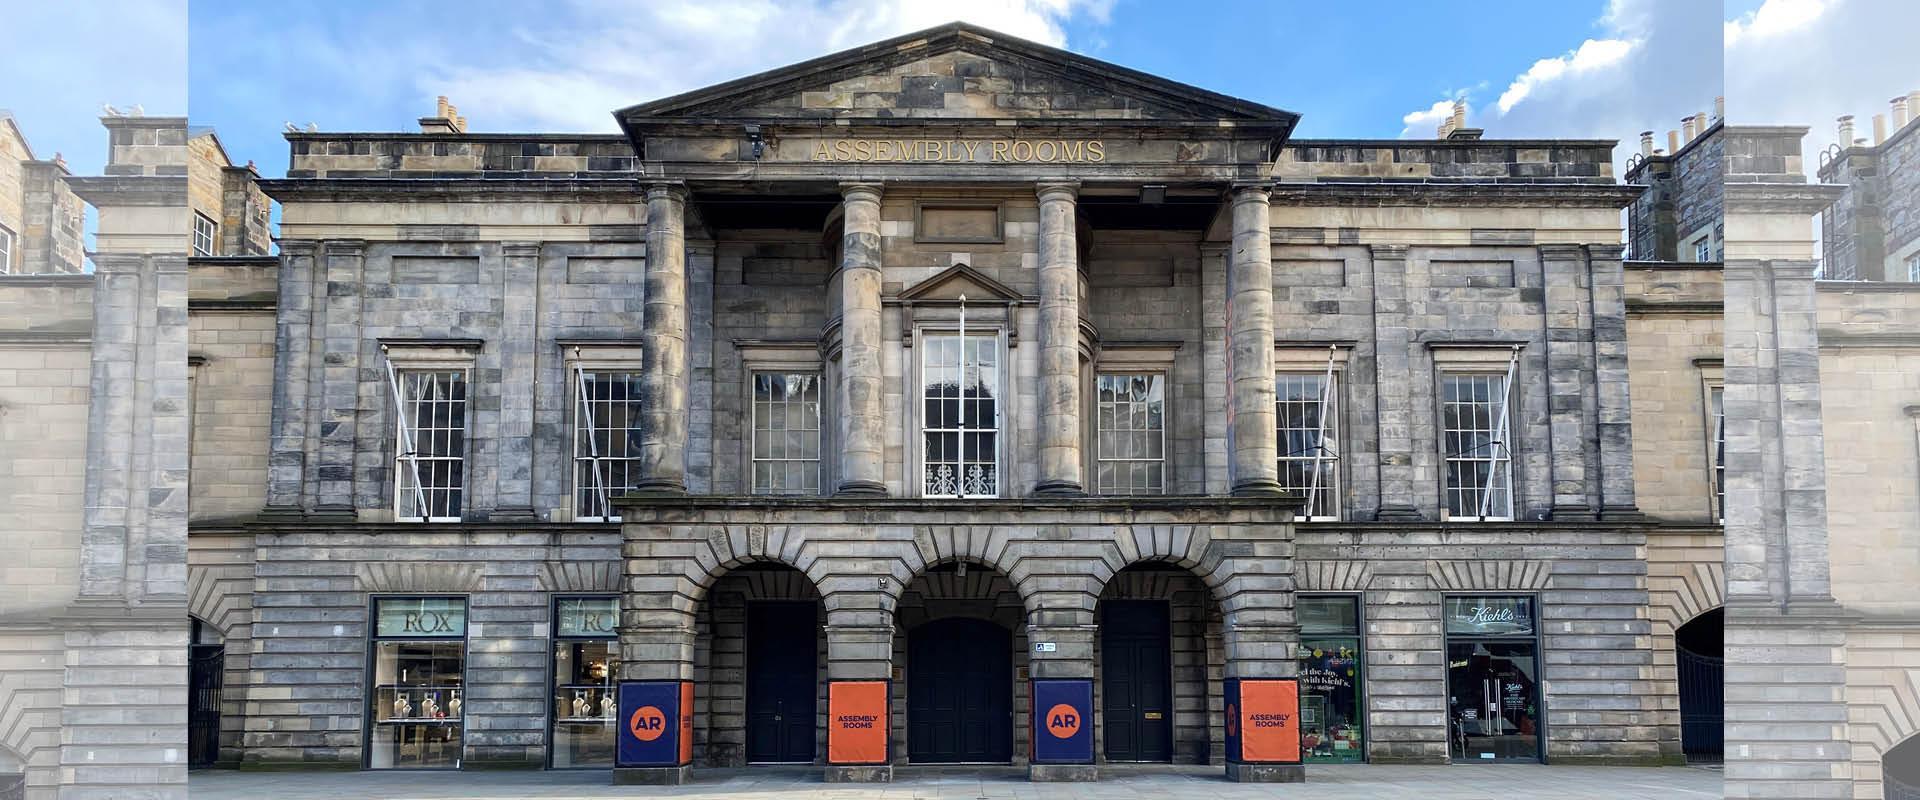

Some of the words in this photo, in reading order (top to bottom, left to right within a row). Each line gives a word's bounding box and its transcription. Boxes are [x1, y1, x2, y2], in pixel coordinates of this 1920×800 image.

[813, 139, 981, 162] ASSEMBLY
[991, 139, 1105, 162] ROOMS
[403, 610, 454, 633] ROX
[1468, 606, 1514, 623] Kiehl's
[1303, 676, 1320, 684] with
[635, 716, 662, 730] AR
[1051, 714, 1076, 728] AR
[1250, 713, 1290, 721] ASSEMBLY
[1255, 720, 1285, 728] ROOMS
